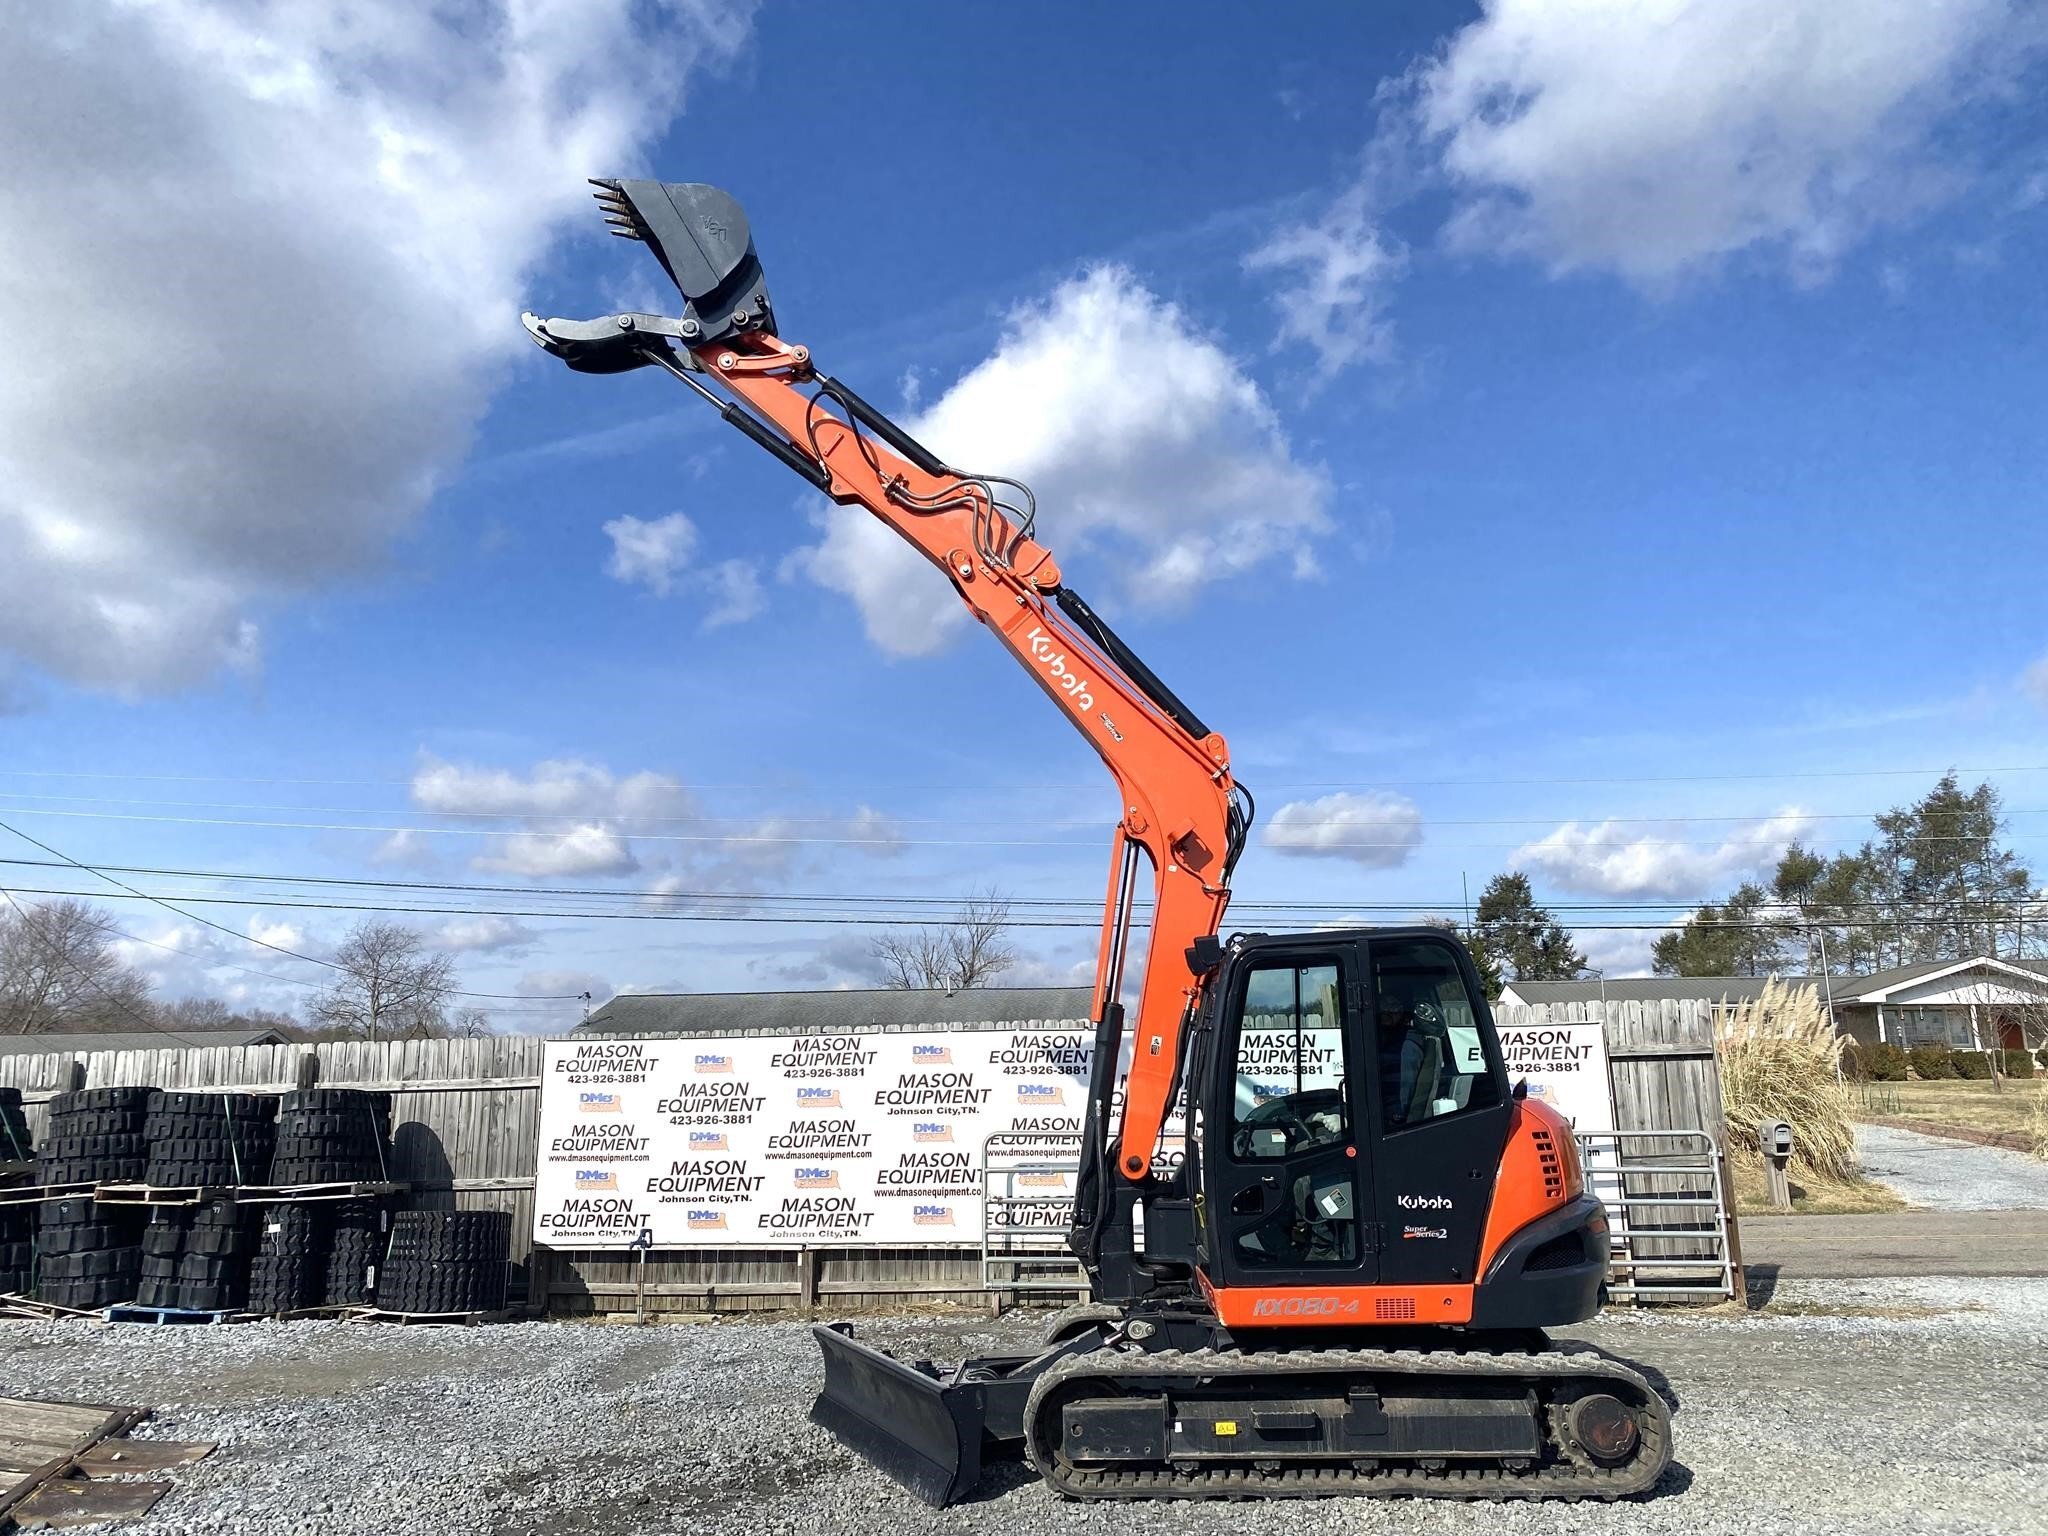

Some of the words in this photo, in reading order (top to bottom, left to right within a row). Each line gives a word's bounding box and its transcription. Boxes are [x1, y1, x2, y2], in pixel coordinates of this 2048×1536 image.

[1027, 626, 1094, 712] Kubota
[792, 1038, 861, 1052] MASON
[1011, 1035, 1082, 1048] MASON
[1245, 1034, 1317, 1048] MASON
[576, 1045, 643, 1058] MASON
[1238, 1049, 1335, 1063] QUIPMENT
[556, 1059, 659, 1073] EQUIPMENT
[771, 1052, 878, 1067] EQUIPMENT
[784, 1068, 864, 1078] 423-926-3881
[1003, 1066, 1087, 1074] 423-926-3881
[1505, 1063, 1580, 1072] 3-926-3881
[567, 1074, 646, 1083] 423-926-3881
[898, 1073, 973, 1088] MASON
[679, 1082, 749, 1097] MASON
[874, 1089, 992, 1105] EQUIPMENT
[657, 1098, 766, 1113] EQUIPMENT
[937, 1107, 979, 1116] City,TN.
[670, 1115, 752, 1125] 423-926-3881
[789, 1120, 855, 1133] MASON
[1012, 1118, 1080, 1130] MASON
[571, 1124, 634, 1137] MASON
[552, 1138, 649, 1151] EQUIPMENT
[768, 1134, 871, 1148] EQUIPMENT
[990, 1135, 1082, 1145] EQUIPMEN
[549, 1154, 649, 1163] www.dmasonequipment.com
[765, 1151, 872, 1161] www.dmasonequipment.com
[899, 1153, 970, 1168] MASON
[670, 1160, 746, 1175] MASON
[646, 1177, 765, 1192] EQUIPMENT
[874, 1187, 981, 1197] www.dmasonequipment.co
[563, 1199, 633, 1212] MASON
[659, 1195, 704, 1203] Johnson
[709, 1194, 752, 1204] City,TN.
[781, 1198, 856, 1212] MASON
[1398, 1195, 1452, 1209] Kubota
[540, 1214, 650, 1227] EQUIPMENT
[758, 1213, 874, 1228] EQUIPMENT
[987, 1212, 1072, 1225] EQUIPME
[770, 1230, 815, 1238] Johnson
[1253, 1297, 1359, 1316] KX080-4
